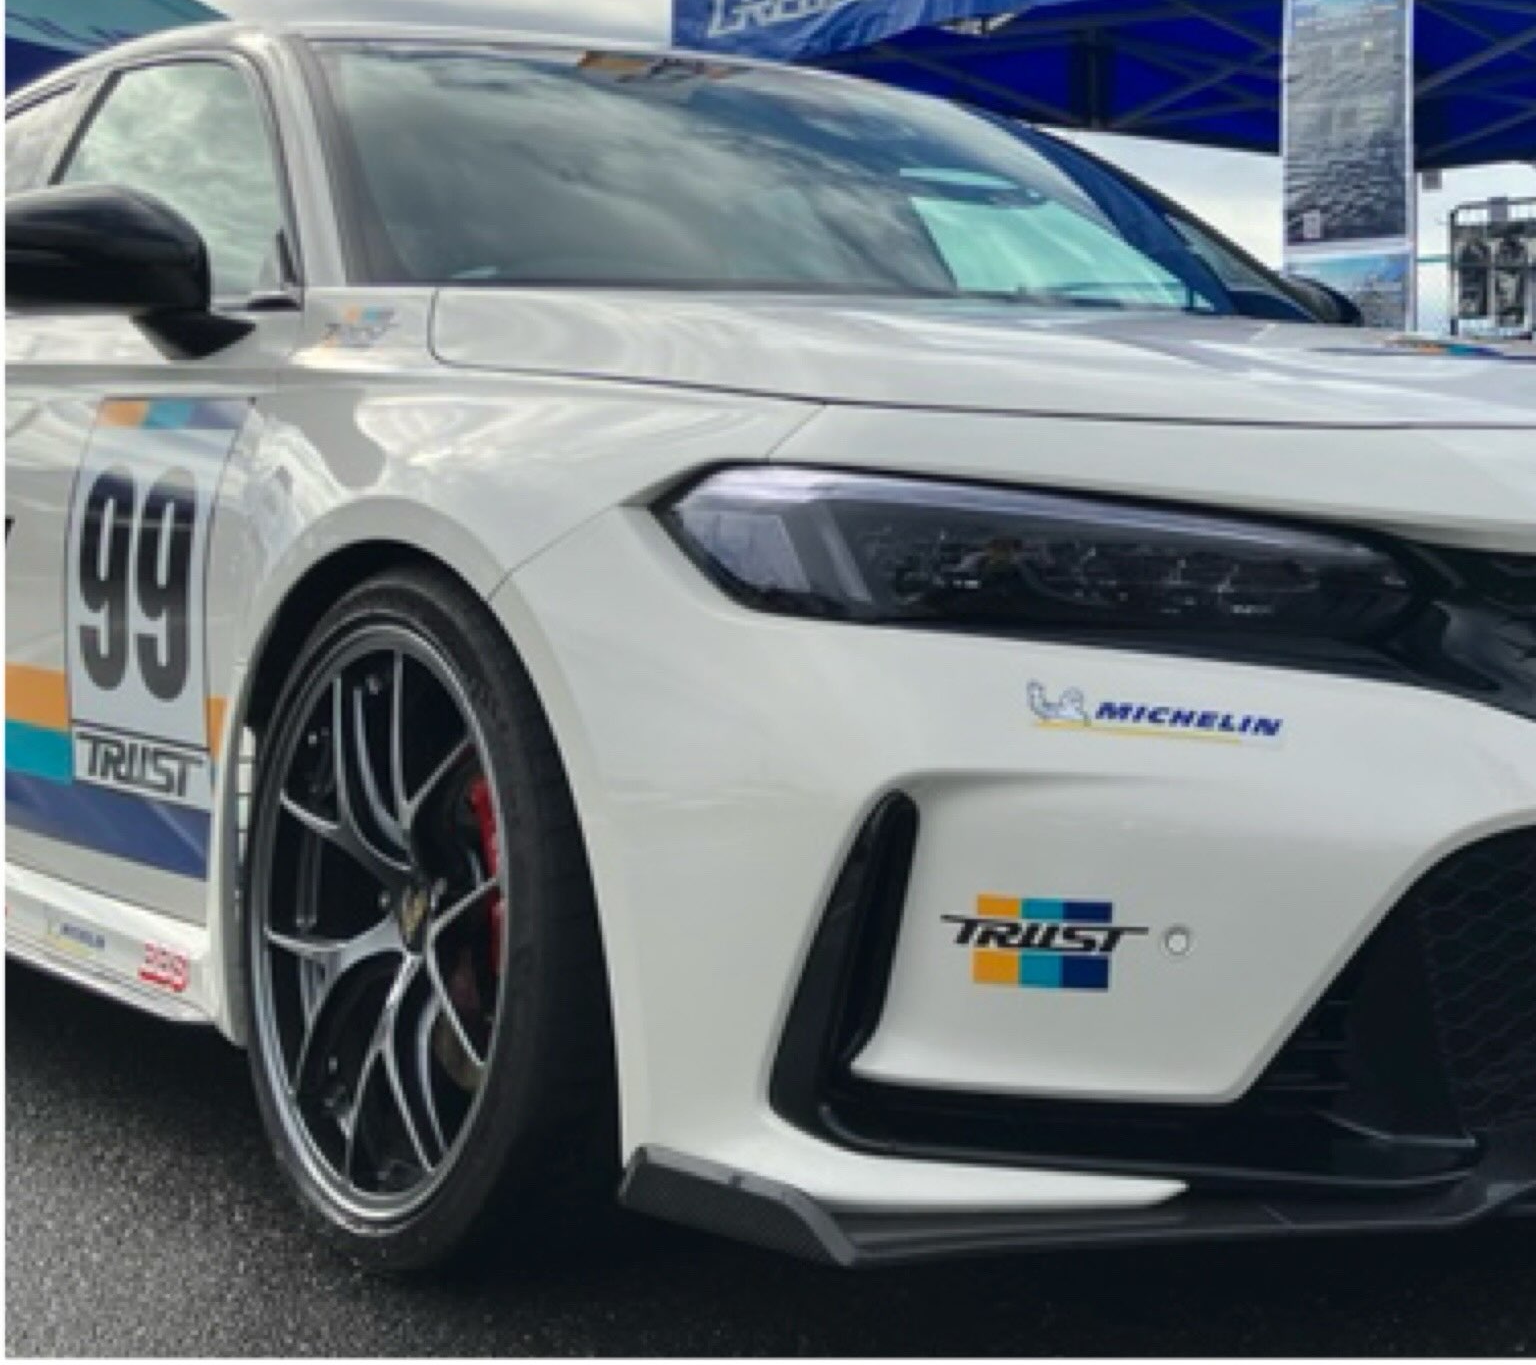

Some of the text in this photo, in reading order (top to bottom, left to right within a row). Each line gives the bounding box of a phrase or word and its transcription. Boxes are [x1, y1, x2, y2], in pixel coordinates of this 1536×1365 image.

[78, 469, 197, 700] 99
[1094, 701, 1284, 737] MICHELIN
[74, 731, 206, 799] TRUST
[939, 913, 1150, 953] TRUST
